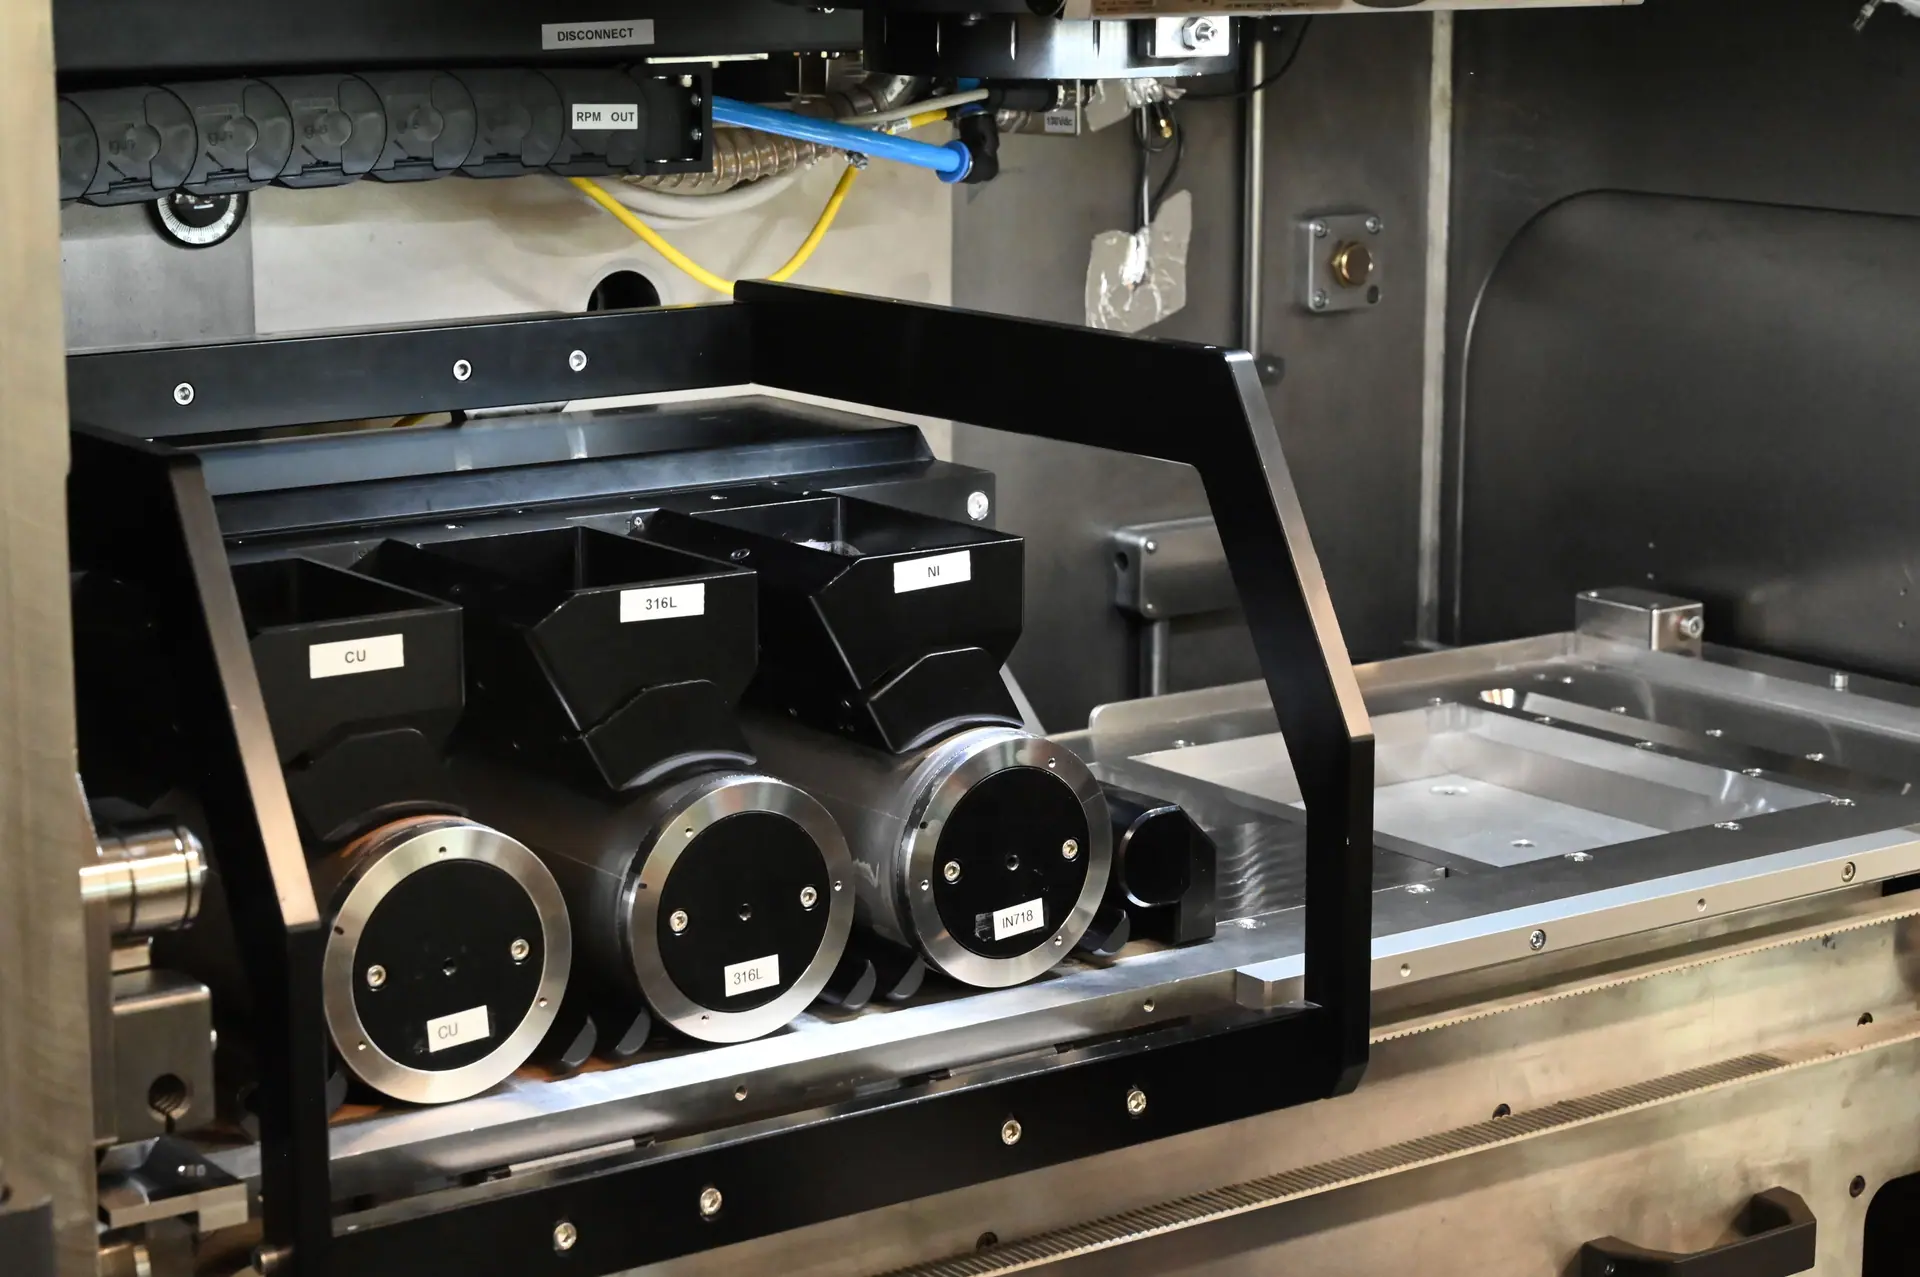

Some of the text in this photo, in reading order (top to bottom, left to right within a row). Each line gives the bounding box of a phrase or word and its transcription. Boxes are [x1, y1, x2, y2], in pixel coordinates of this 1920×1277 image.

[557, 27, 634, 41] DISCONNECT
[577, 111, 635, 122] RPM OUT
[927, 565, 940, 578] NI
[645, 596, 678, 611] 316L
[344, 649, 366, 664] CU
[1001, 909, 1034, 929] IN718
[733, 967, 764, 986] 316L
[437, 1022, 459, 1040] CU
